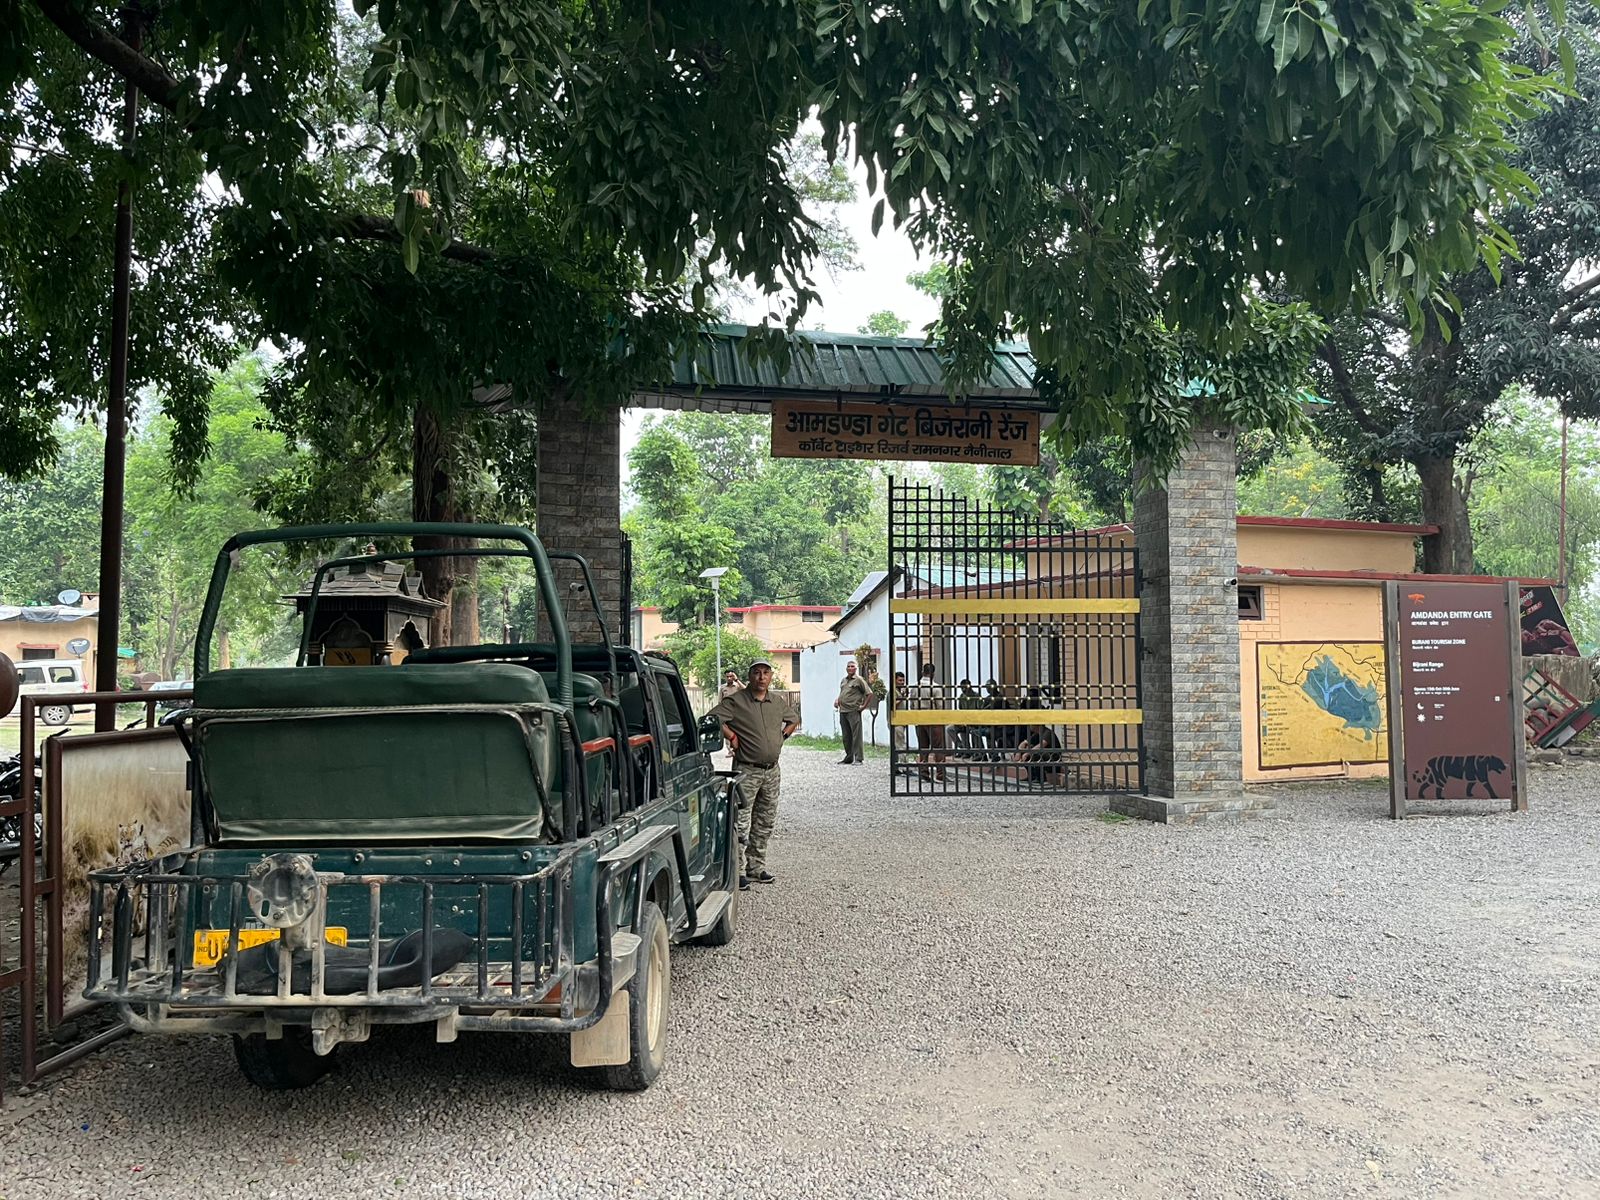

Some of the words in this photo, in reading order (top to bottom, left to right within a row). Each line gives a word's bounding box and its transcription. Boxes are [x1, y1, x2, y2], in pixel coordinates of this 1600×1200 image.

[877, 407, 909, 437] गेट
[997, 411, 1029, 441] रेंज
[877, 439, 910, 454] रिजर्व
[912, 443, 961, 457] रामनगर
[963, 443, 1012, 460] नैनीताल
[1411, 611, 1448, 619] AMDANDA
[1449, 611, 1472, 619] ENTRY
[1473, 610, 1492, 619] GATE
